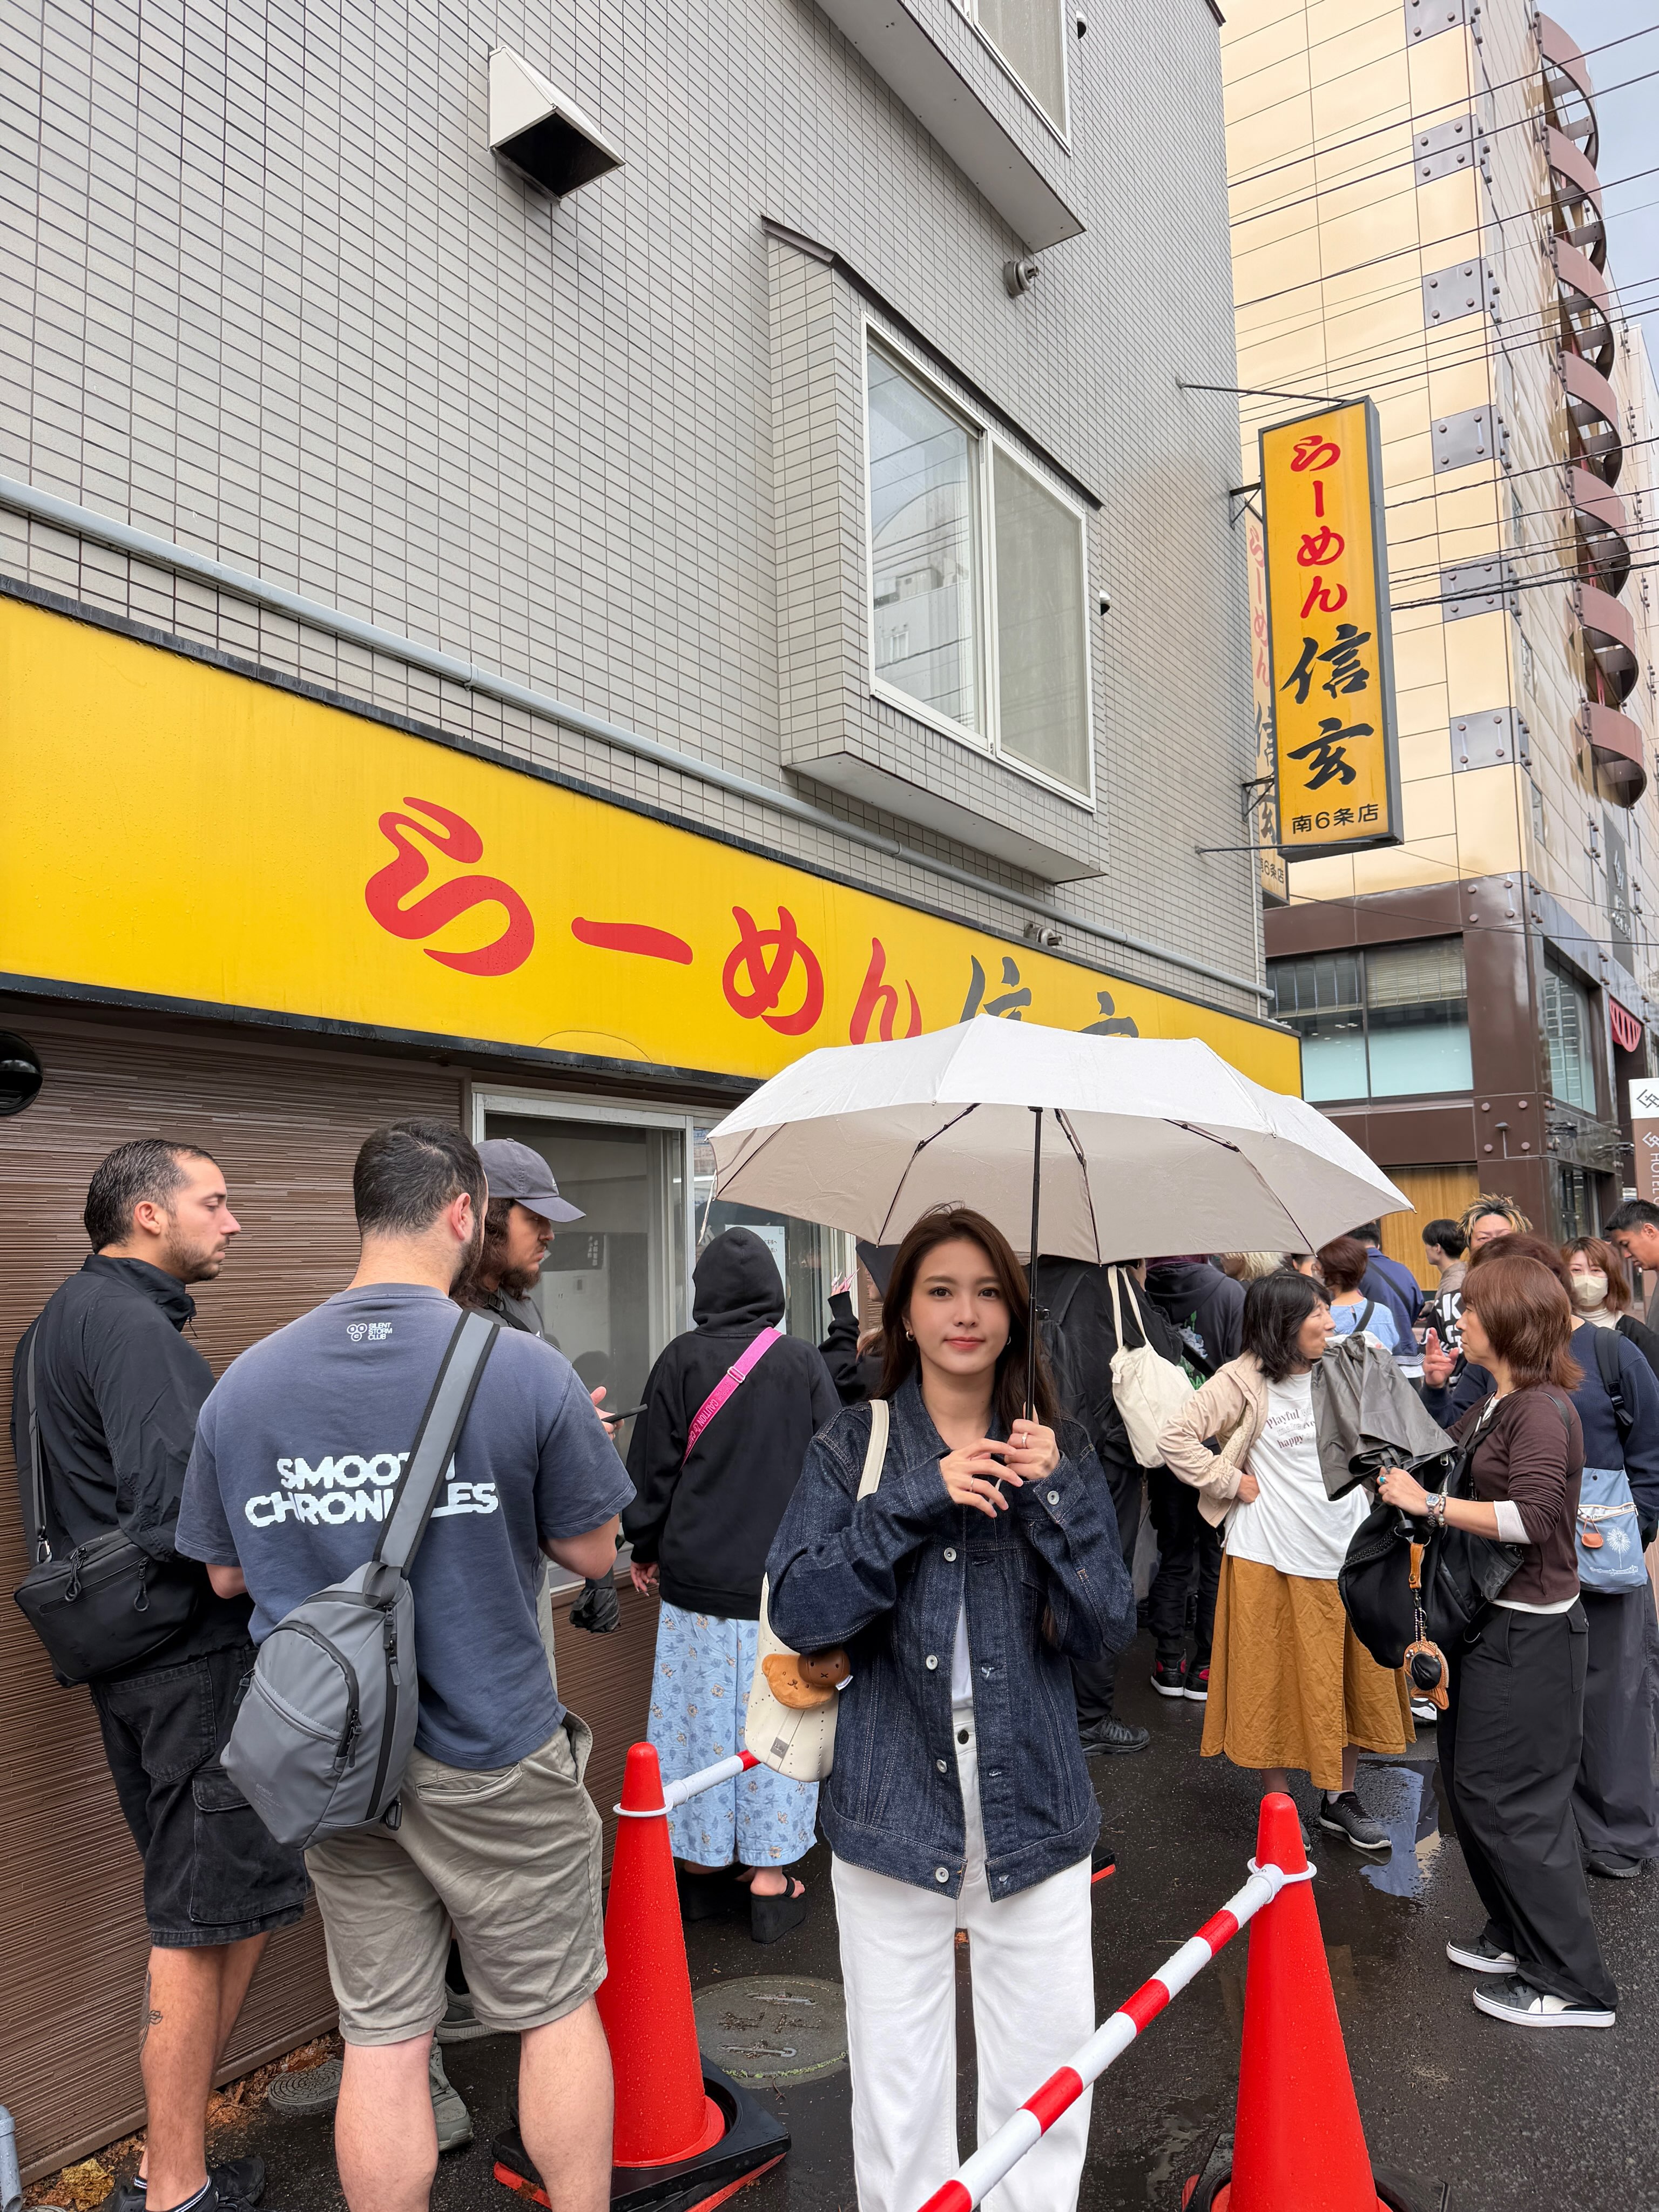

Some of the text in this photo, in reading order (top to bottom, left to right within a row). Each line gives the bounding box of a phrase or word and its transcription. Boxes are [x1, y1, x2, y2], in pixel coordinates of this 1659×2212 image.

[1279, 435, 1374, 791] らーめん信玄
[1292, 804, 1379, 834] 南6条店
[697, 1398, 719, 1426] CAUTION
[1266, 1408, 1299, 1429] Playful
[1277, 1434, 1303, 1448] happy
[277, 1452, 455, 1490] SMOO
[245, 1482, 499, 1527] CHRONIES
